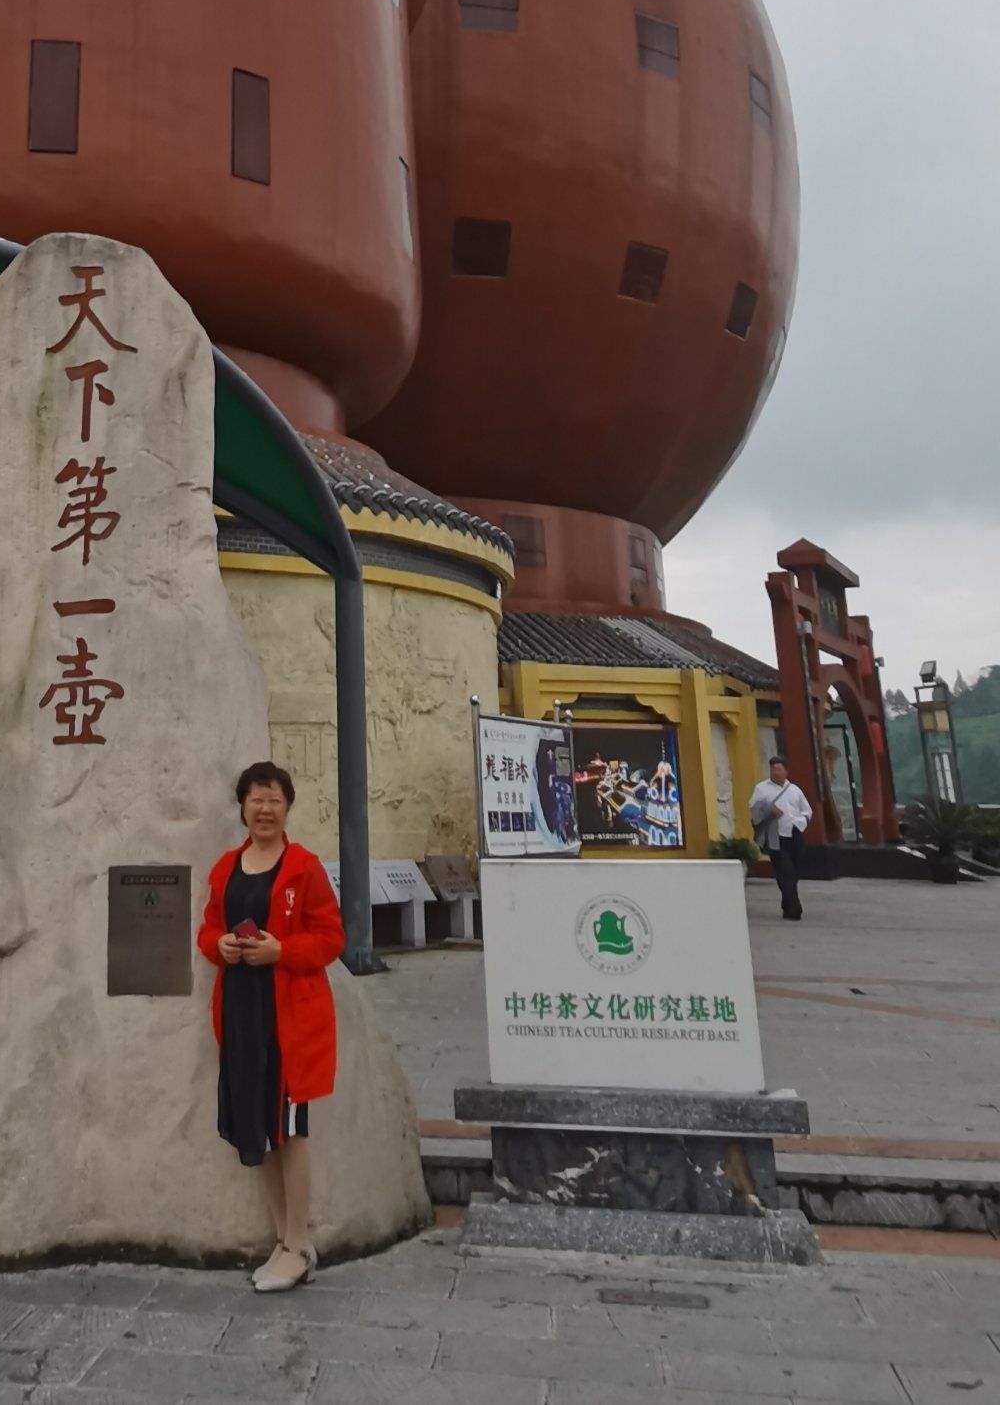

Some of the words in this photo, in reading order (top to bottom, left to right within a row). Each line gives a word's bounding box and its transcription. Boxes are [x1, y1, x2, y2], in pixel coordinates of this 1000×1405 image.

[504, 992, 738, 1023] 中华茶文化研究基地
[506, 1024, 557, 1037] CHINESE
[559, 1026, 583, 1037] TEA
[584, 1027, 639, 1039] CULTURE
[641, 1028, 706, 1041] RESEARCH
[707, 1029, 740, 1041] BASE
